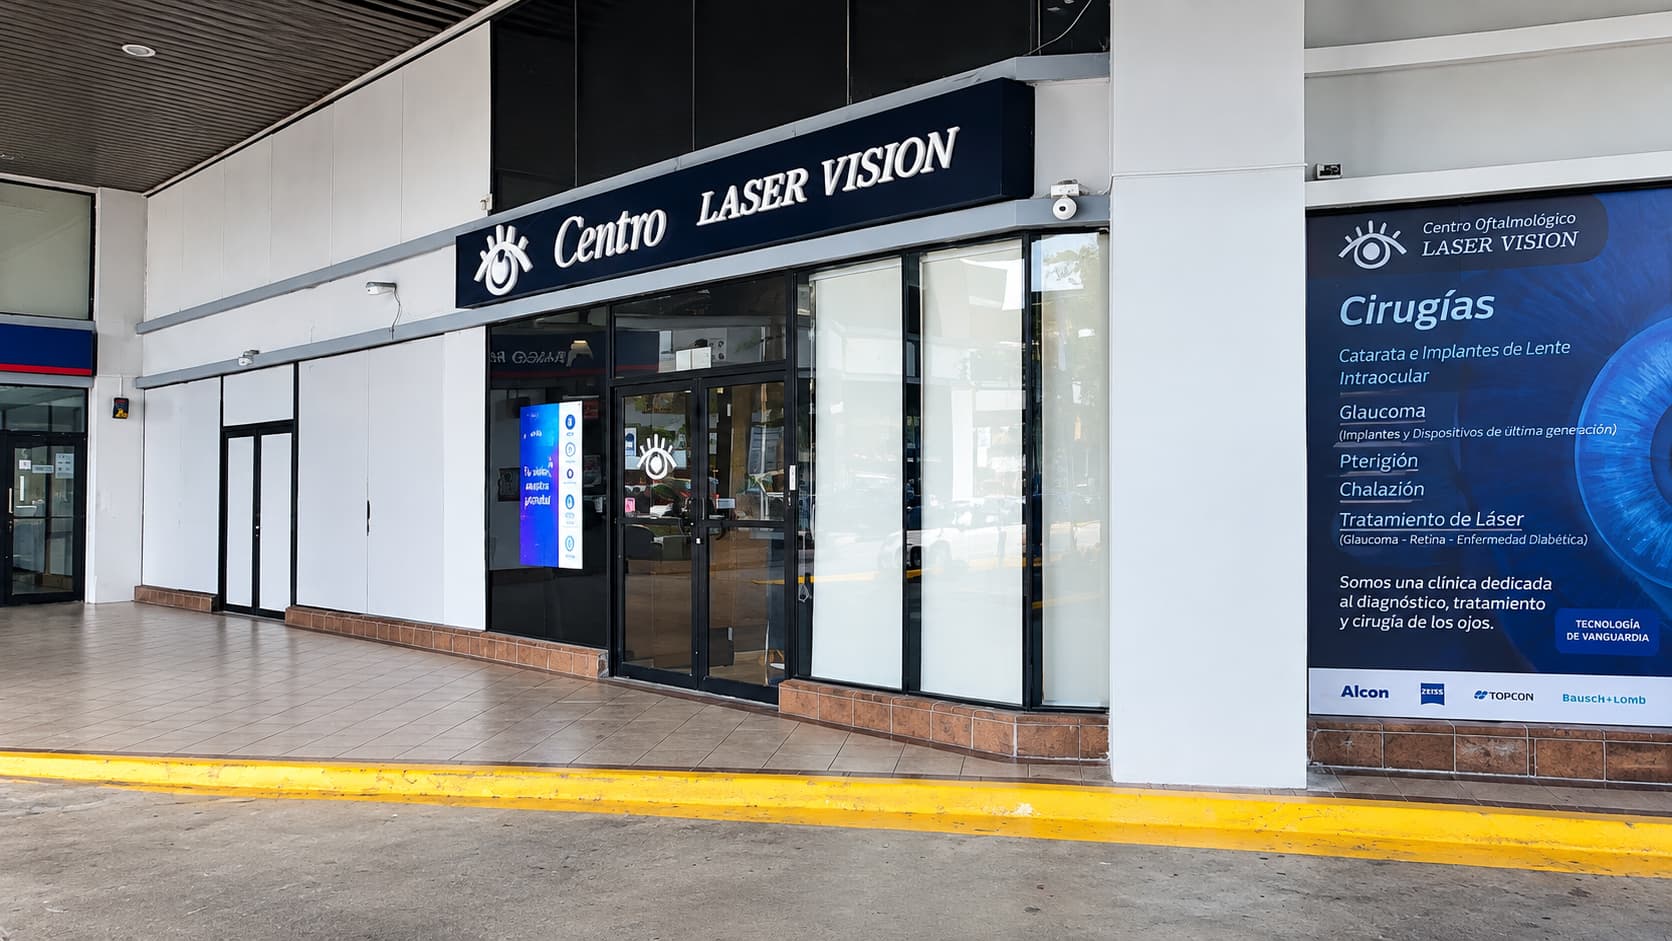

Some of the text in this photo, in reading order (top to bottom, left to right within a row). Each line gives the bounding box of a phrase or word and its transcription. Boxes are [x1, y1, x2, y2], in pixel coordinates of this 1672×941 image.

[554, 126, 961, 268] Centro LASER VISION
[1423, 213, 1576, 234] Centro Oftalmológico
[1422, 231, 1579, 256] LASER VISION
[1340, 290, 1495, 330] Cirugías
[1339, 341, 1571, 364] Catarata e Implantes de Lente
[1339, 370, 1429, 385] Intraocular
[1339, 404, 1426, 420] Glaucoma
[1339, 428, 1400, 442] (Implantes
[1403, 431, 1410, 440] y
[1412, 426, 1483, 439] Dispositivos
[1486, 426, 1502, 438] de
[1340, 453, 1419, 472] Pterigión
[1339, 480, 1425, 497] Chalazión
[1339, 511, 1524, 527] Tratamiento de Láser
[1339, 534, 1399, 546] (Glaucoma
[1410, 534, 1446, 545] Retina
[1457, 534, 1526, 545] Enfermedad
[1340, 575, 1552, 591] Somos una clínica dedicada
[1339, 595, 1546, 612] al diagnóstico, tratamiento
[1339, 614, 1494, 632] y cirugía de los ojos.
[1576, 617, 1641, 630] TECNOLOGÍA
[1566, 631, 1649, 643] DE VANGUARDIA
[1341, 685, 1389, 699] Alcon
[1489, 691, 1534, 702] TOPCON
